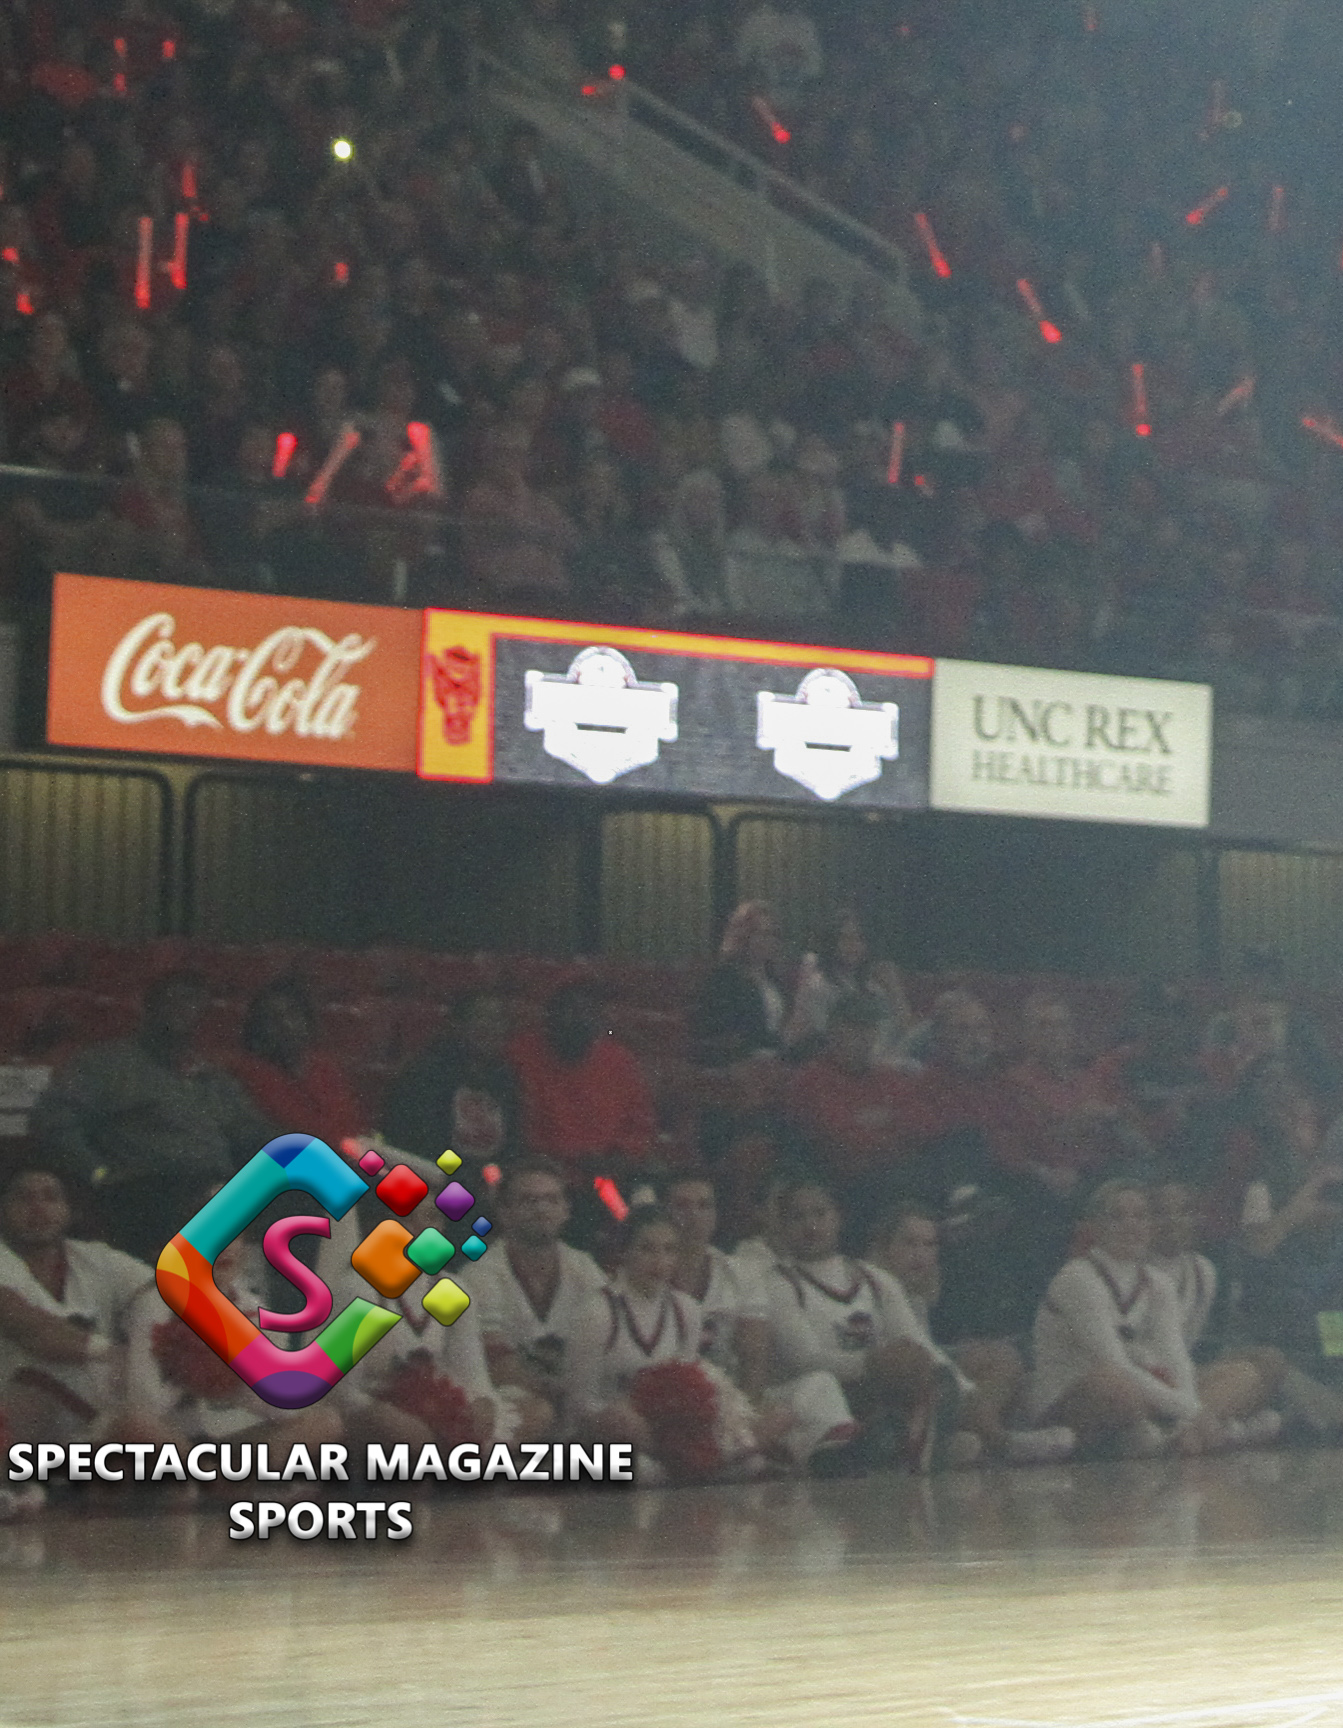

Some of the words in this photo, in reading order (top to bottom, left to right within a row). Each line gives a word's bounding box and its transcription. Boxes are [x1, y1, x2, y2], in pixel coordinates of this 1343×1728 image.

[101, 612, 378, 740] Coca-Cola
[972, 694, 1073, 747] UNC
[1084, 703, 1174, 755] REX
[971, 748, 1174, 795] HEALTHCARE
